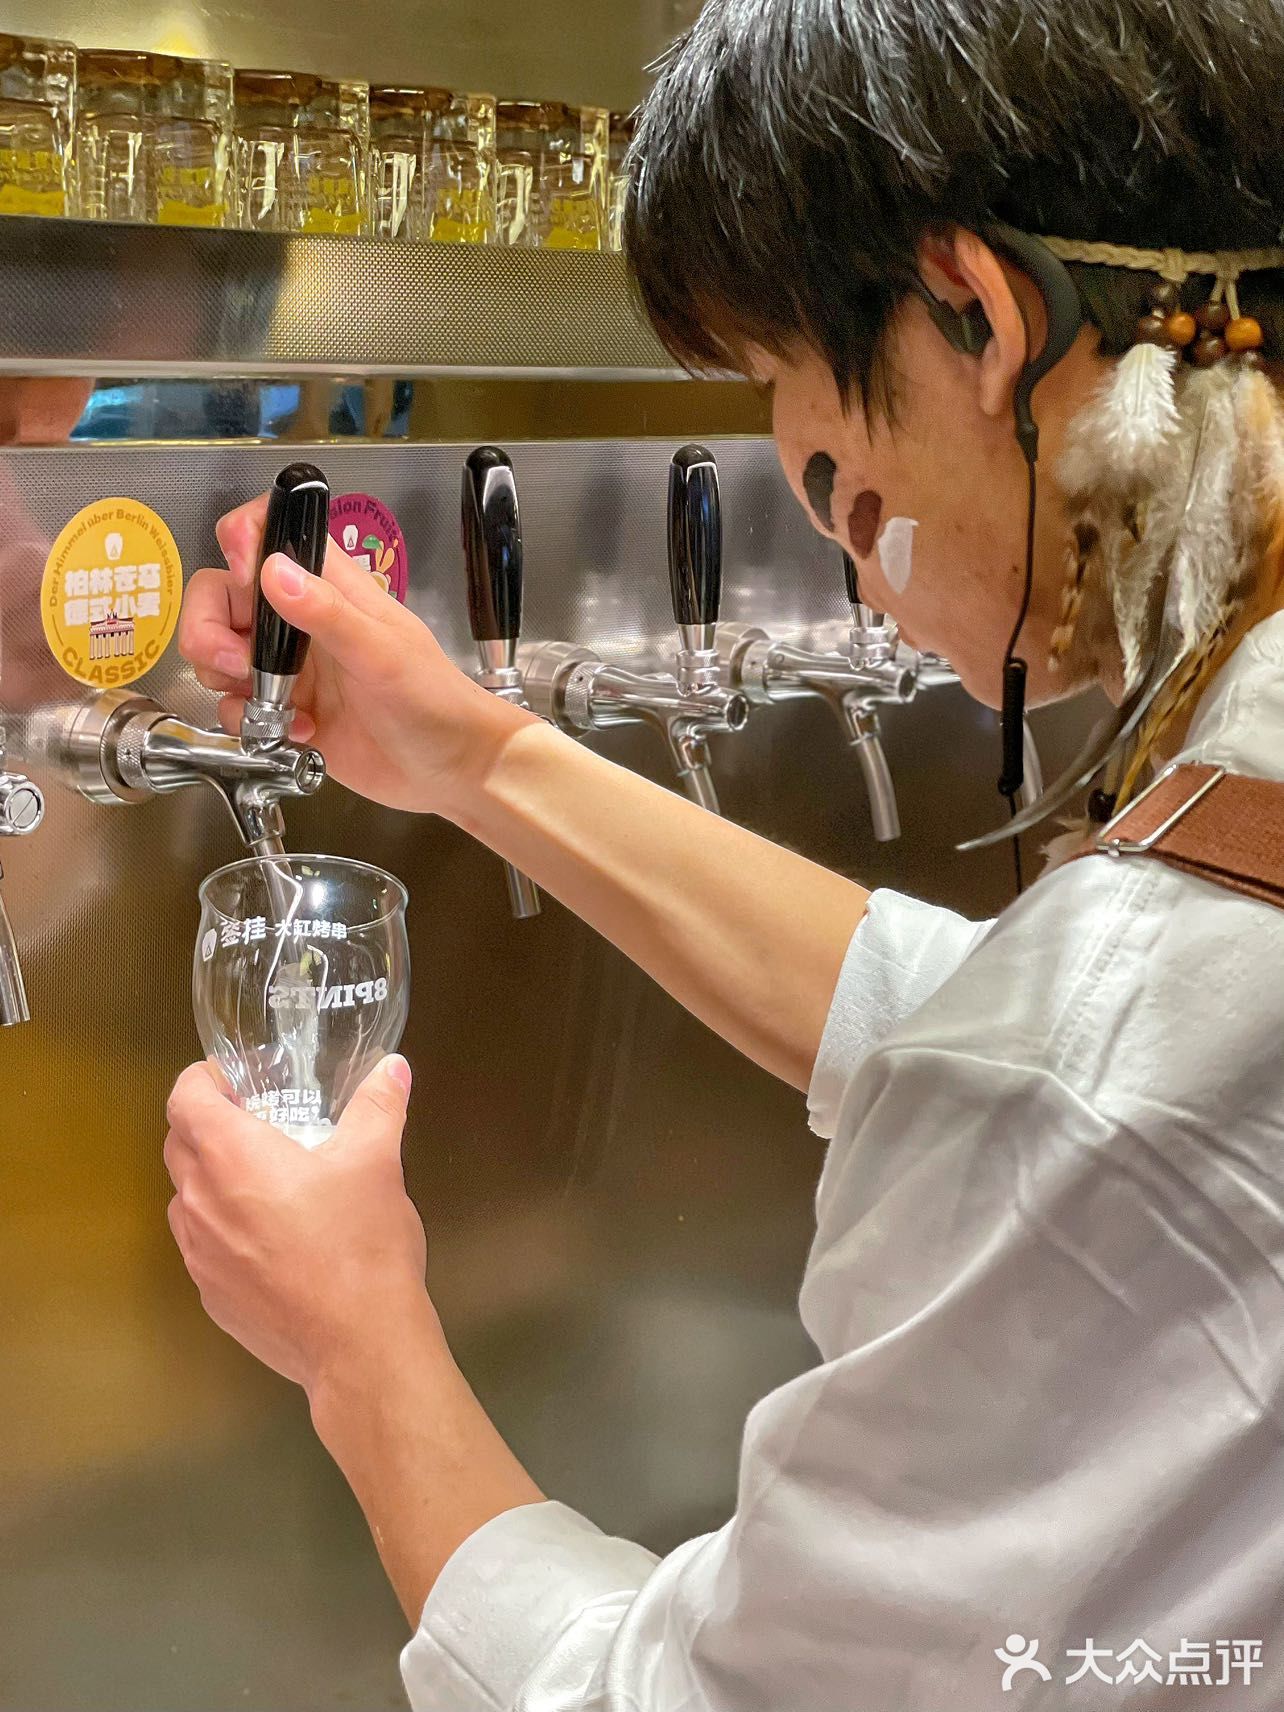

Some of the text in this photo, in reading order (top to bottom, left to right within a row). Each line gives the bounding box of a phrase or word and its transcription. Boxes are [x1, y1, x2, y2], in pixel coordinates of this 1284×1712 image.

[364, 501, 398, 543] Fruit
[50, 578, 61, 607] Der
[56, 525, 88, 576] Himmel
[116, 508, 149, 532] Berlin
[62, 639, 160, 684] CLASSIC
